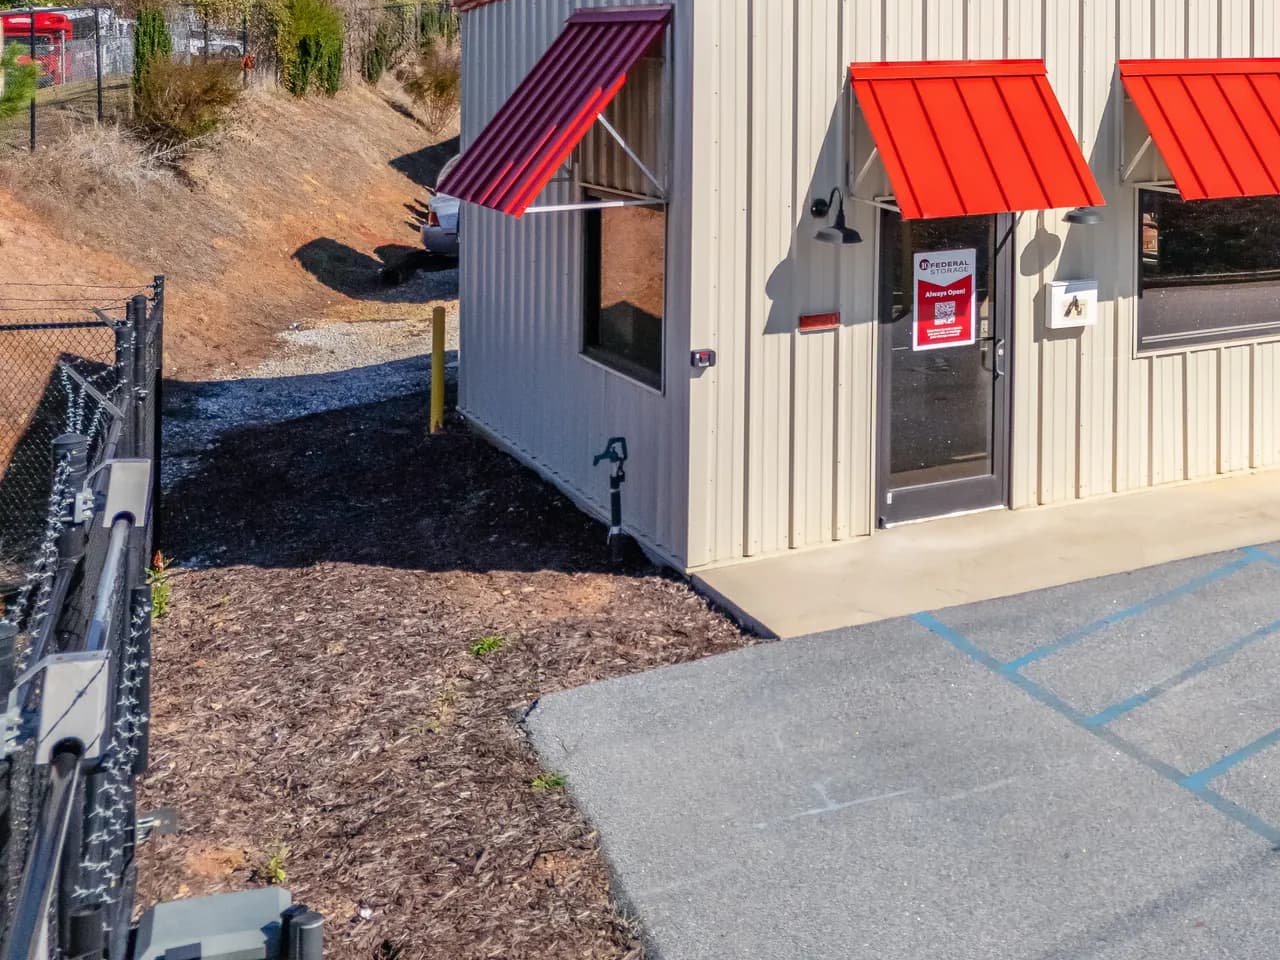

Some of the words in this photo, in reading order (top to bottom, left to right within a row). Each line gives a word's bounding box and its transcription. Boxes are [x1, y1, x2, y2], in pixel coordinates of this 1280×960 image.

[930, 260, 969, 268] FEDERAL
[930, 267, 968, 275] STORAGE
[925, 290, 947, 298] Always
[947, 288, 965, 296] Open!
